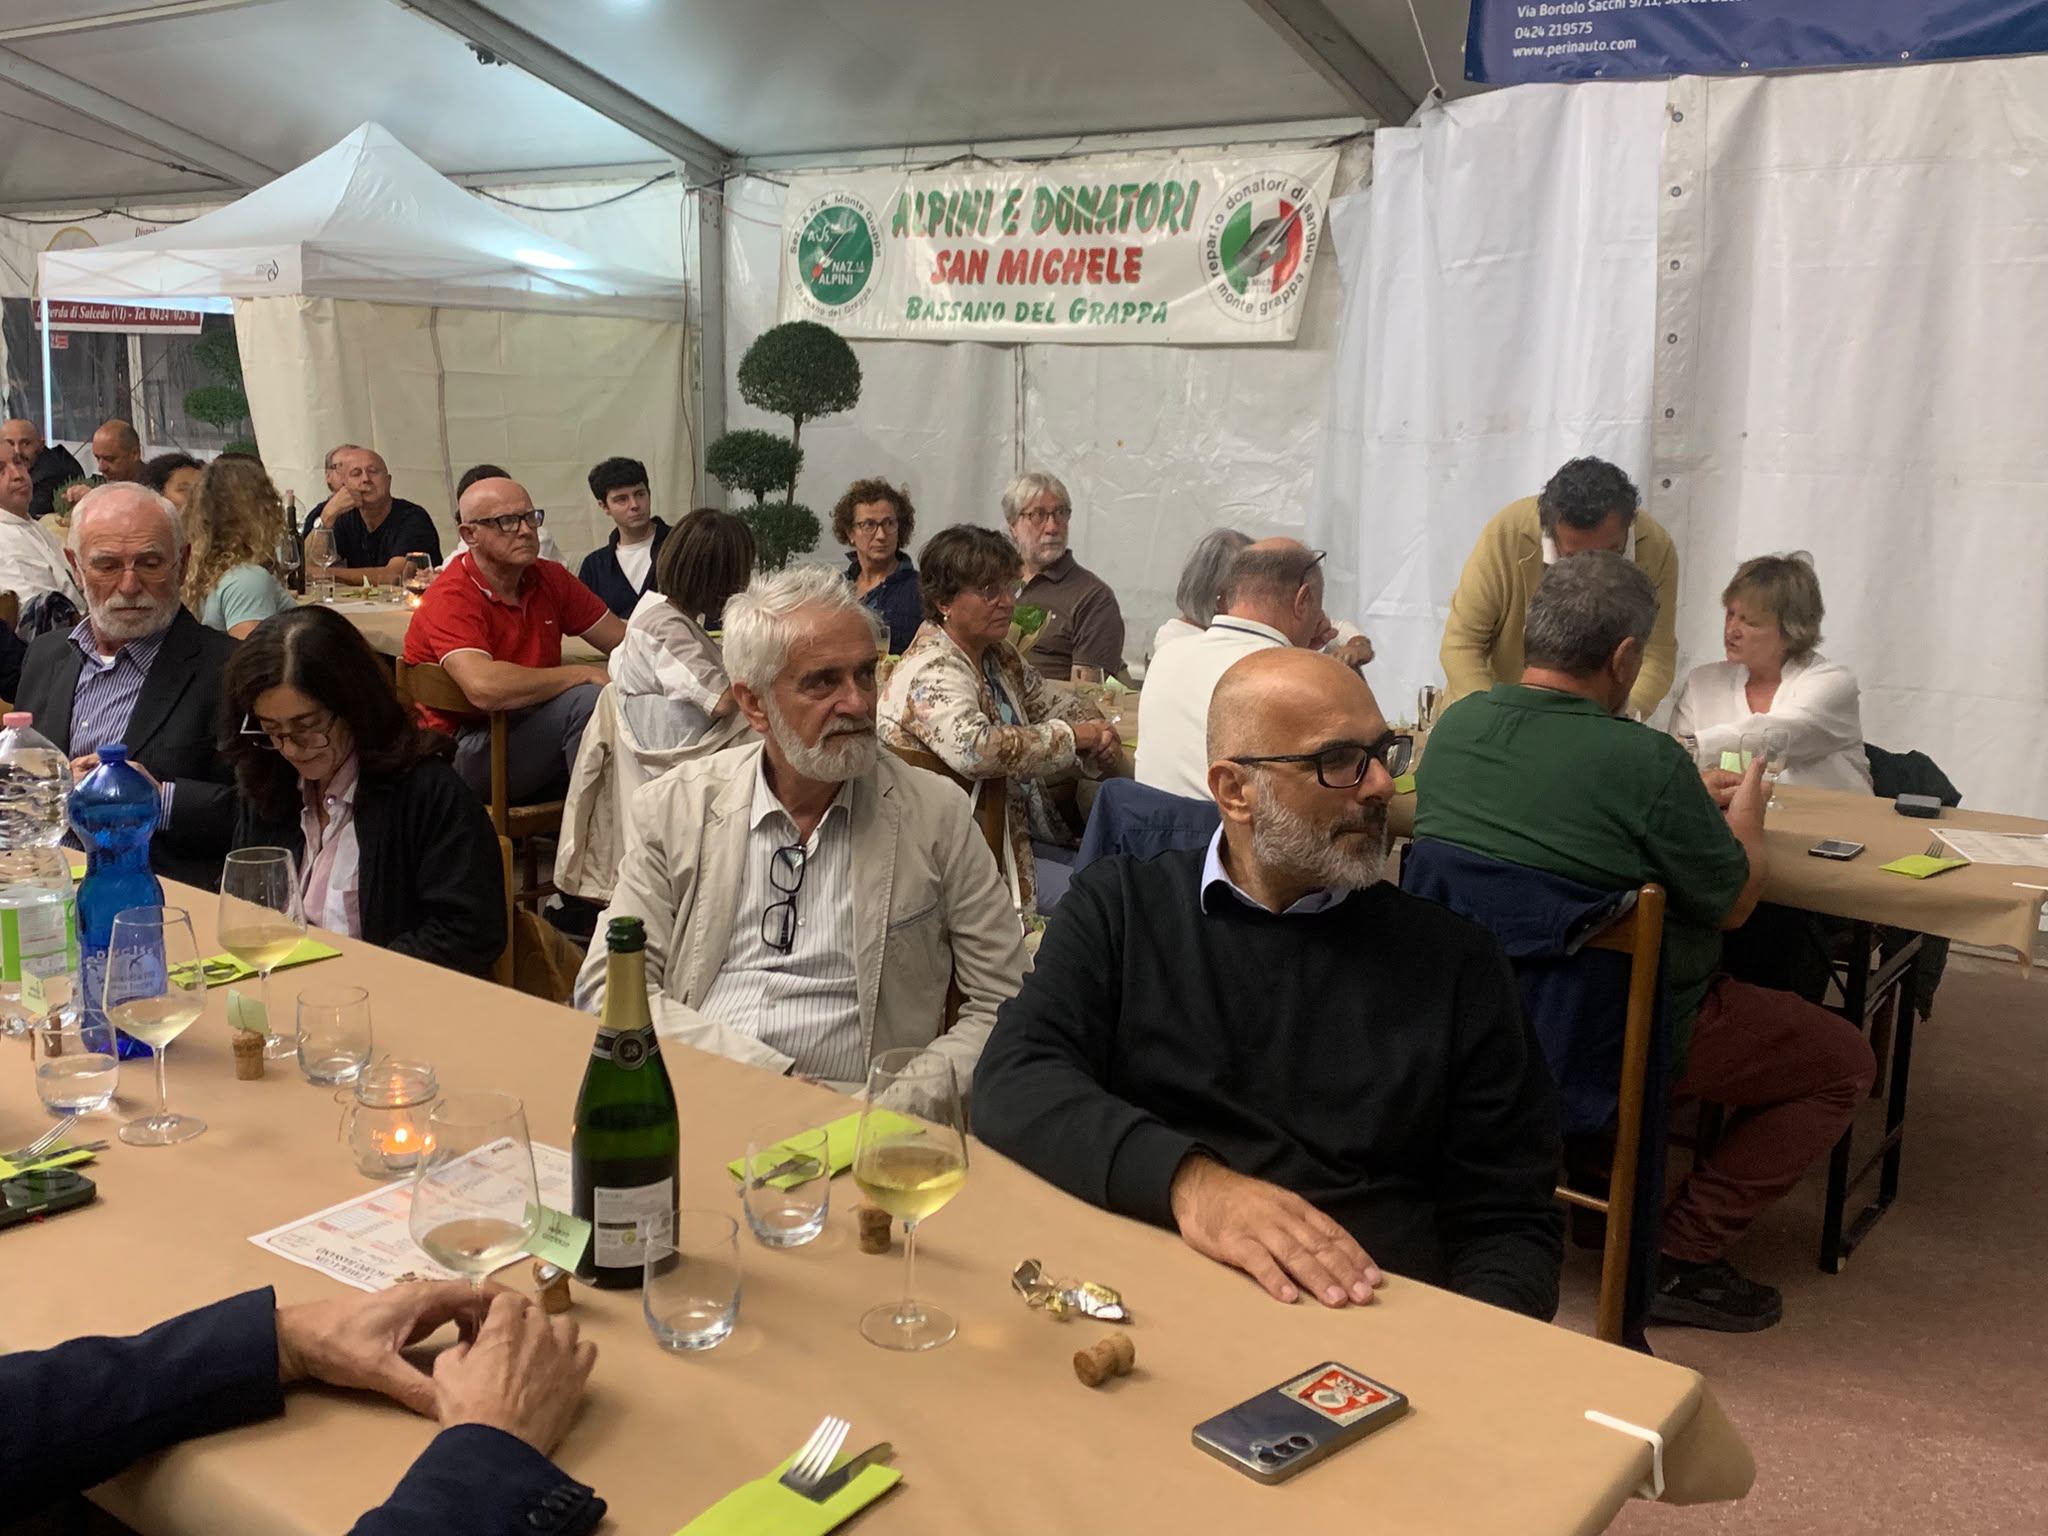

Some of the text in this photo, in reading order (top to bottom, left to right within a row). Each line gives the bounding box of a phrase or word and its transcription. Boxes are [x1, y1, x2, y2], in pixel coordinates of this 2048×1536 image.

[1517, 6, 1536, 18] Via
[1539, 2, 1585, 16] Bortolo
[1588, 0, 1625, 12] Sacchi
[1515, 21, 1593, 40] 0424 219575
[1512, 38, 1637, 57] www.perinauto.com
[892, 180, 1200, 238] ALPINI E DONATORI
[835, 195, 864, 211] Monte
[866, 211, 881, 258] Grappa
[1206, 214, 1224, 279] reparto
[1226, 178, 1288, 210] donatori
[1304, 203, 1317, 263] sangue
[818, 273, 853, 285] ALPINI
[931, 247, 1143, 285] SAN MICHELE
[828, 308, 841, 317] del
[844, 287, 872, 313] Grappa
[1217, 273, 1304, 316] monte grappa
[70, 305, 79, 318] di
[79, 305, 110, 319] Salcedo
[112, 306, 126, 322] (VI)
[906, 296, 1168, 324] BASSANO DEL GRAPPA
